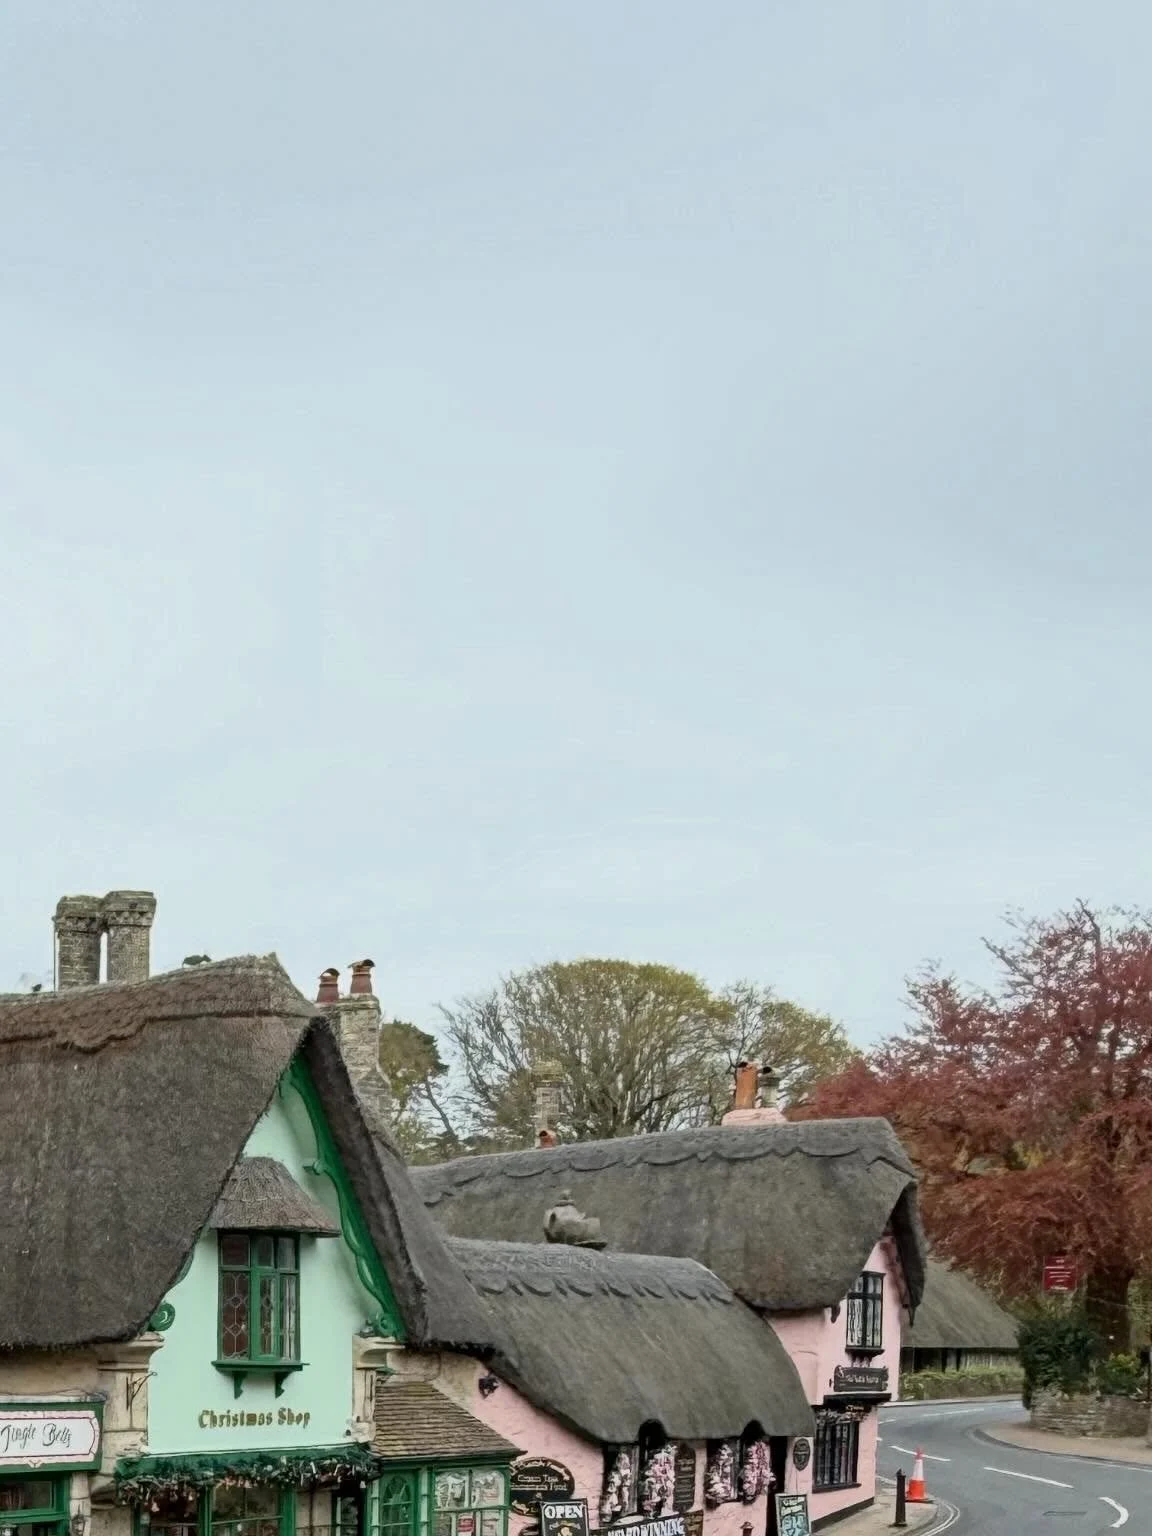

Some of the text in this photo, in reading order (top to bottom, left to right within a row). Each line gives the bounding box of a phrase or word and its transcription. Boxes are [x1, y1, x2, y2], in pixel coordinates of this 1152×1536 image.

[199, 1407, 311, 1429] Christmas Shop
[544, 1505, 584, 1519] OPEN
